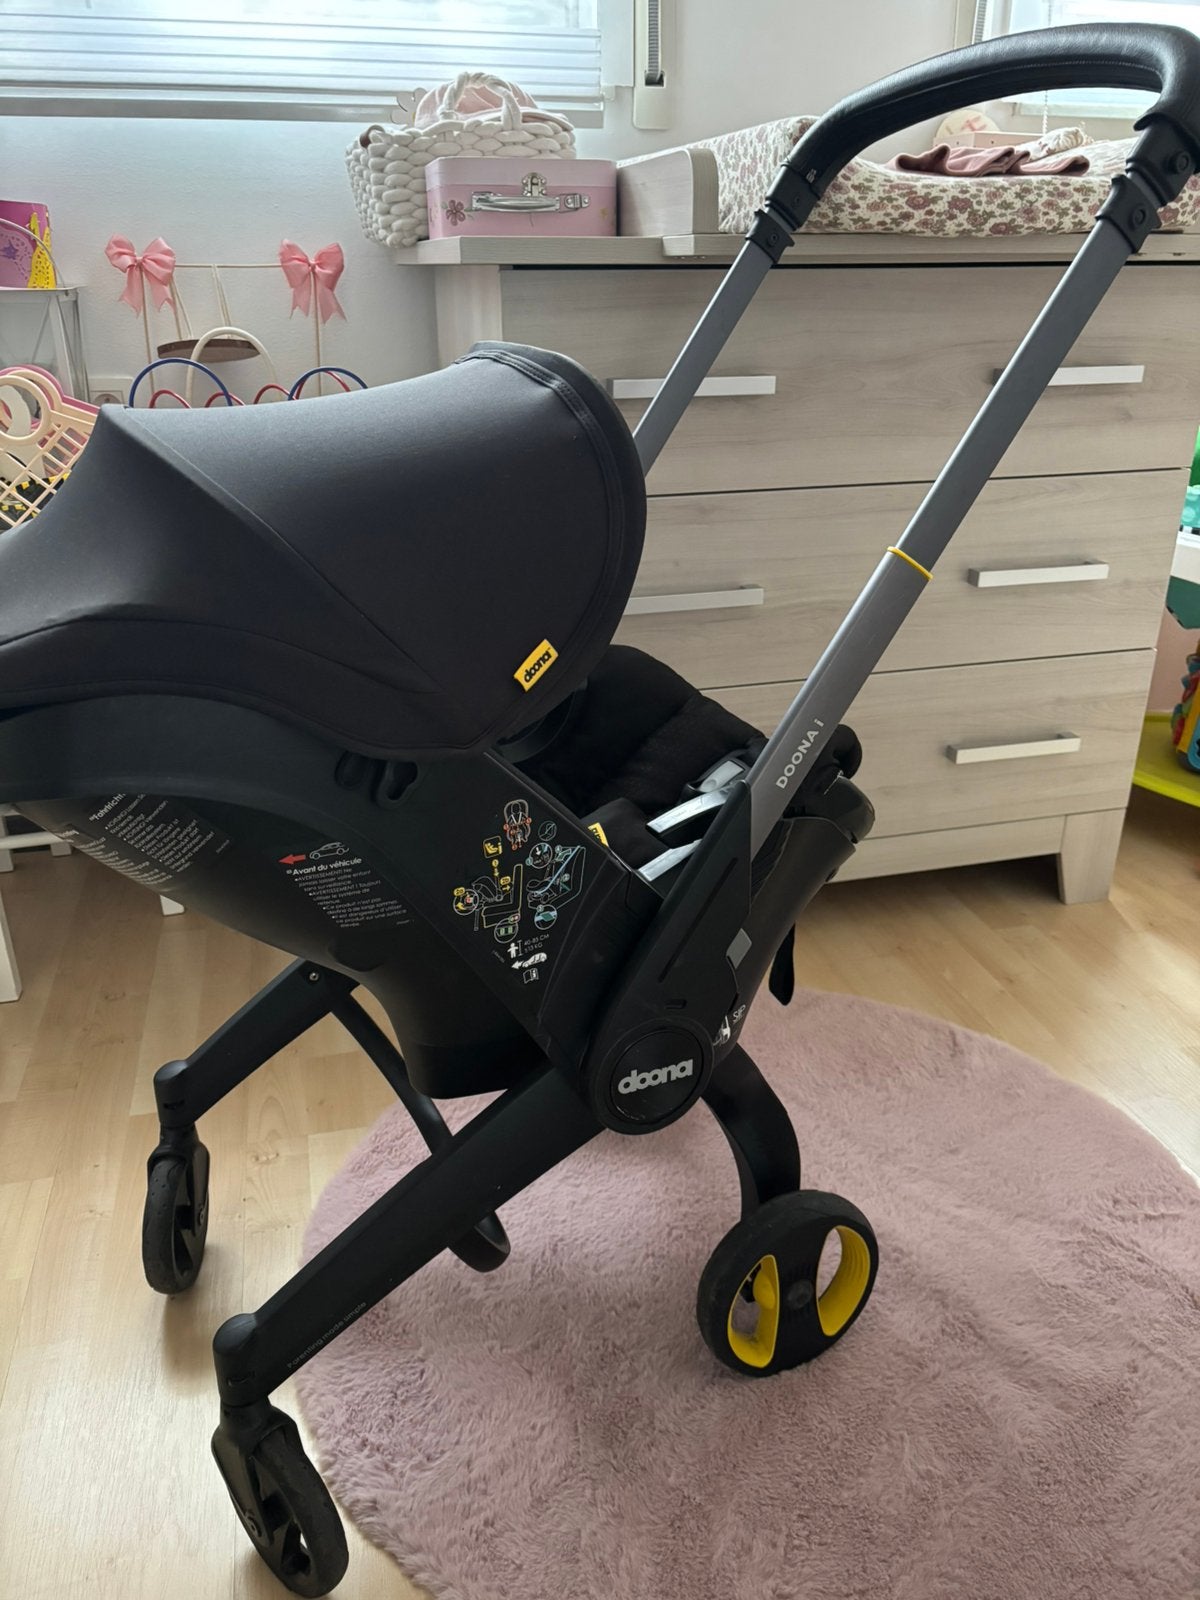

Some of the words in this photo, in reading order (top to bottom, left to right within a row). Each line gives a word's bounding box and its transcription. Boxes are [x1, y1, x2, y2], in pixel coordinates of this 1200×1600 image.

[524, 650, 552, 683] doona
[775, 730, 819, 789] DOONA
[292, 865, 316, 875] Avant
[317, 864, 328, 872] du
[329, 857, 362, 869] véhicule
[617, 1058, 694, 1095] doona
